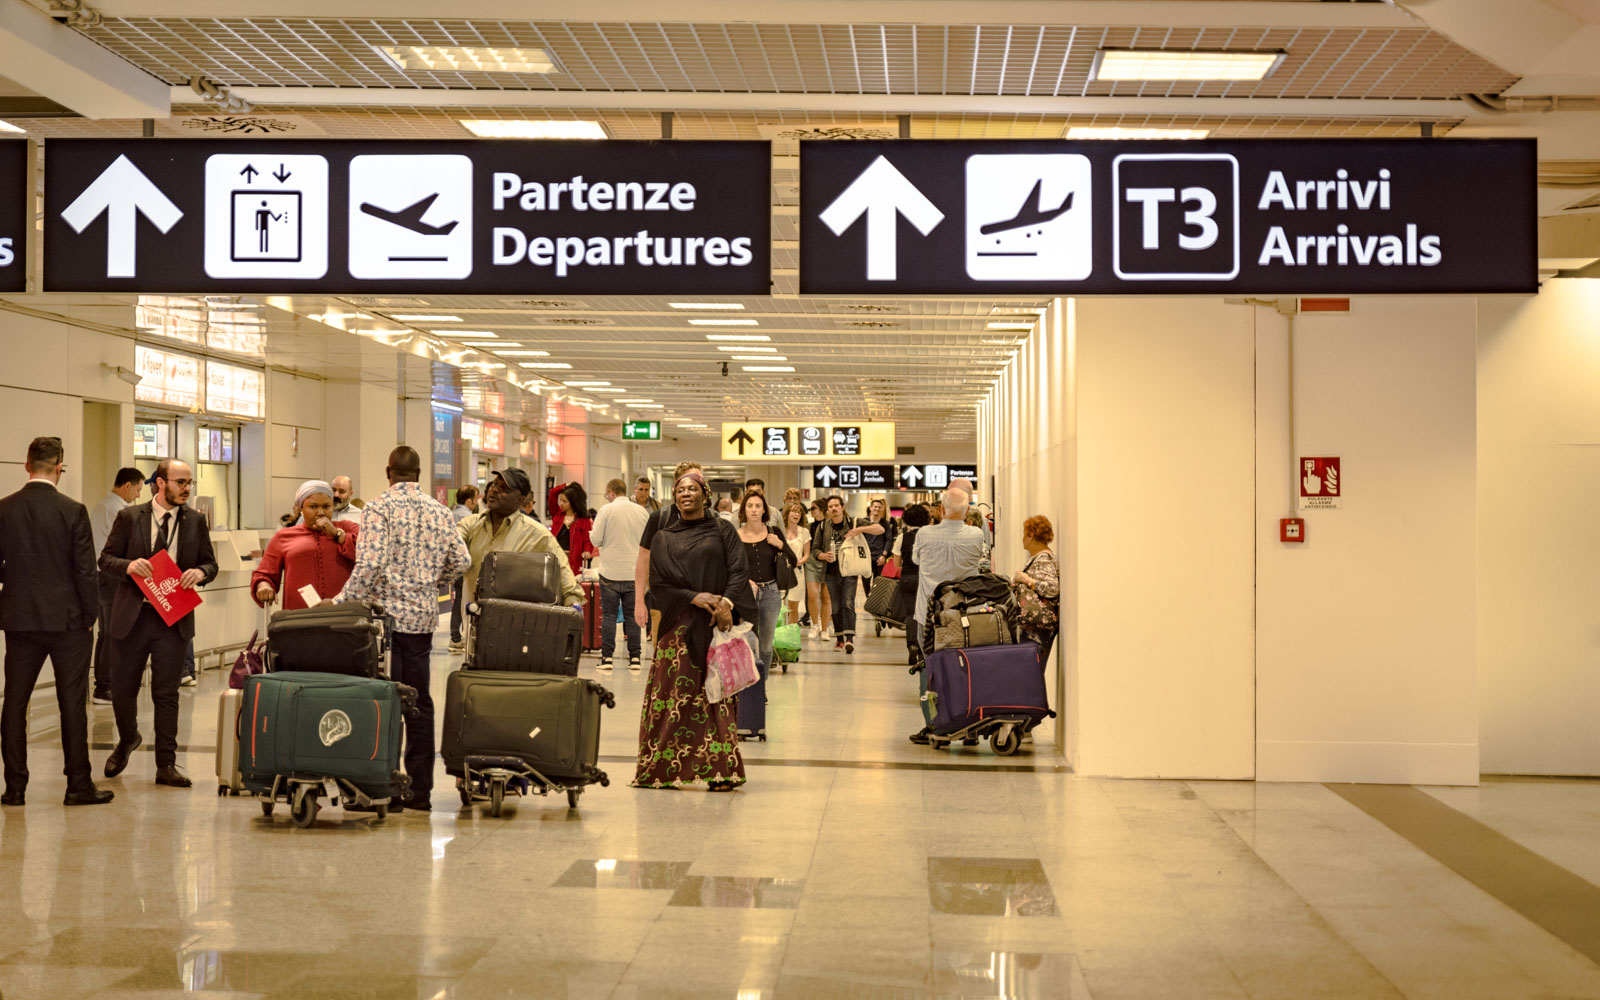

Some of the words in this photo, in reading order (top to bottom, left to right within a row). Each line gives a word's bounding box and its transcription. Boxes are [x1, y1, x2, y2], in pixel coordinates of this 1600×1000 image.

[493, 172, 697, 211] Partenze
[1258, 168, 1391, 210] Arrivi
[1126, 187, 1219, 250] T3
[492, 226, 753, 277] Departures
[1258, 224, 1442, 266] Arrivals
[841, 470, 858, 483] T3
[144, 577, 173, 612] Emirates
